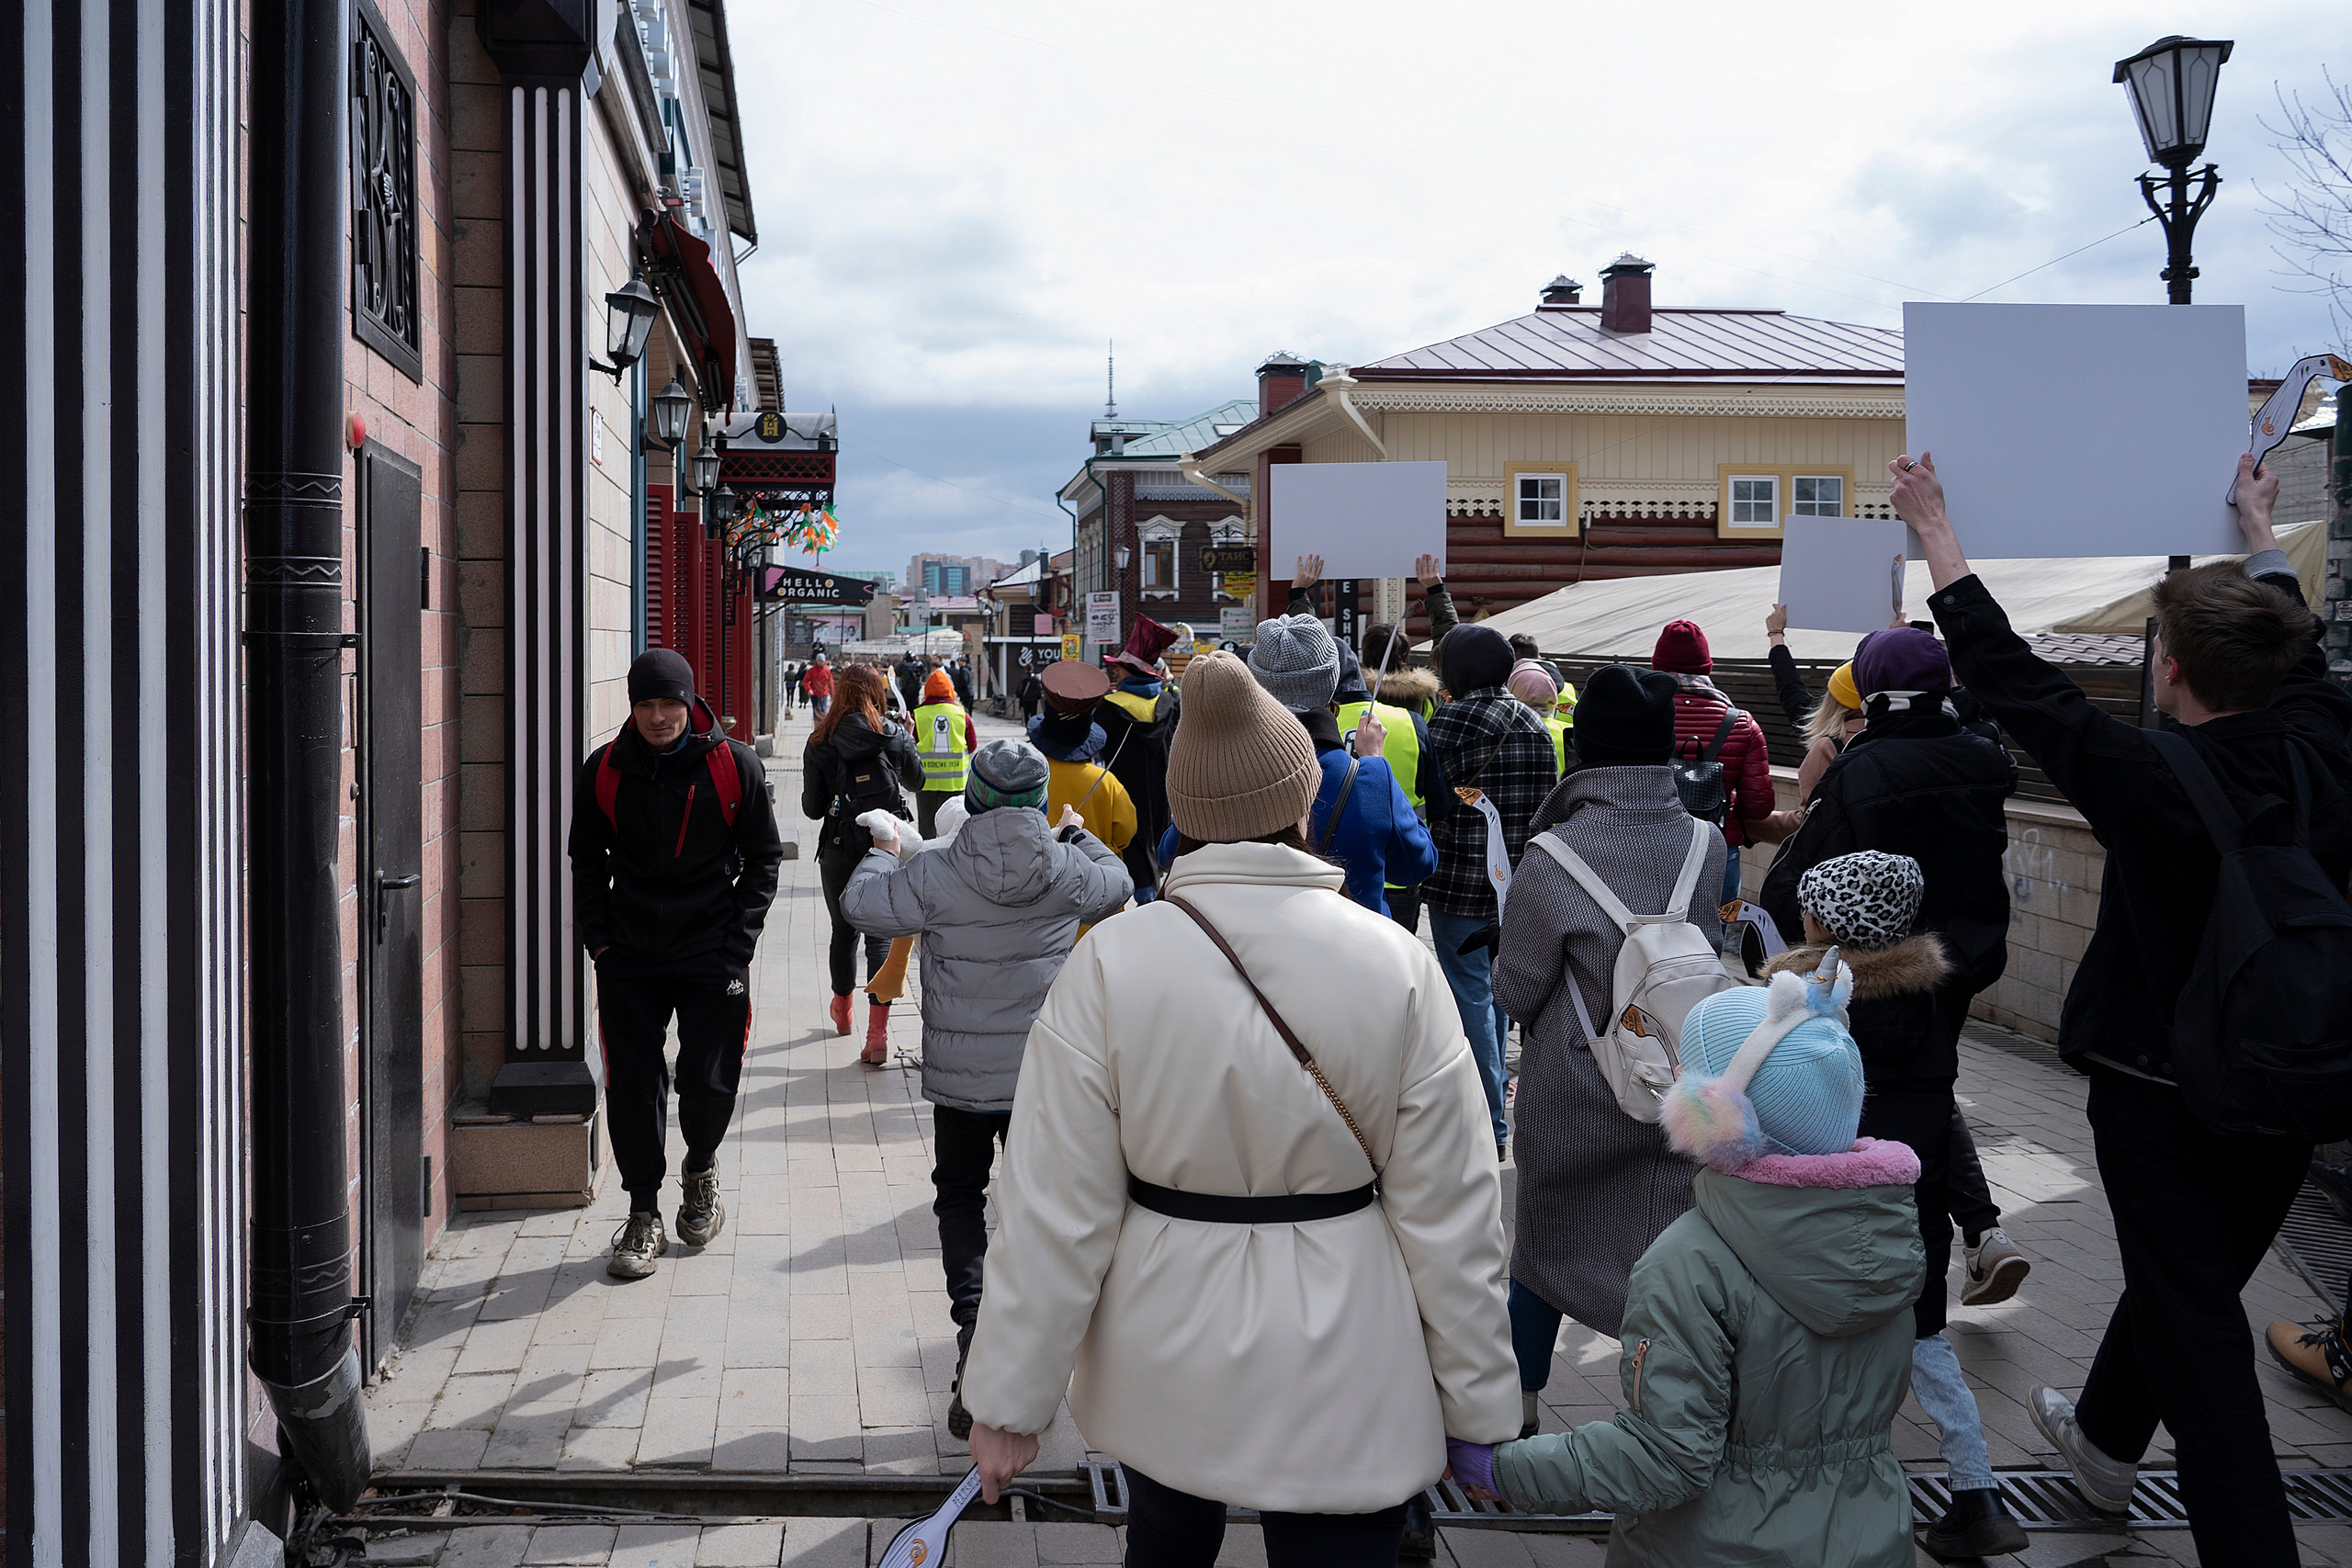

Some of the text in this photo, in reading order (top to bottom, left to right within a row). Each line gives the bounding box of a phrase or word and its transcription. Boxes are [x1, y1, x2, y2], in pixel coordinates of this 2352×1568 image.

[1218, 551, 1250, 561] ТАИС
[783, 578, 834, 588] HELLO
[777, 587, 840, 598] ORGANIC
[1037, 648, 1061, 660] YOU
[727, 987, 744, 996] Kappa
